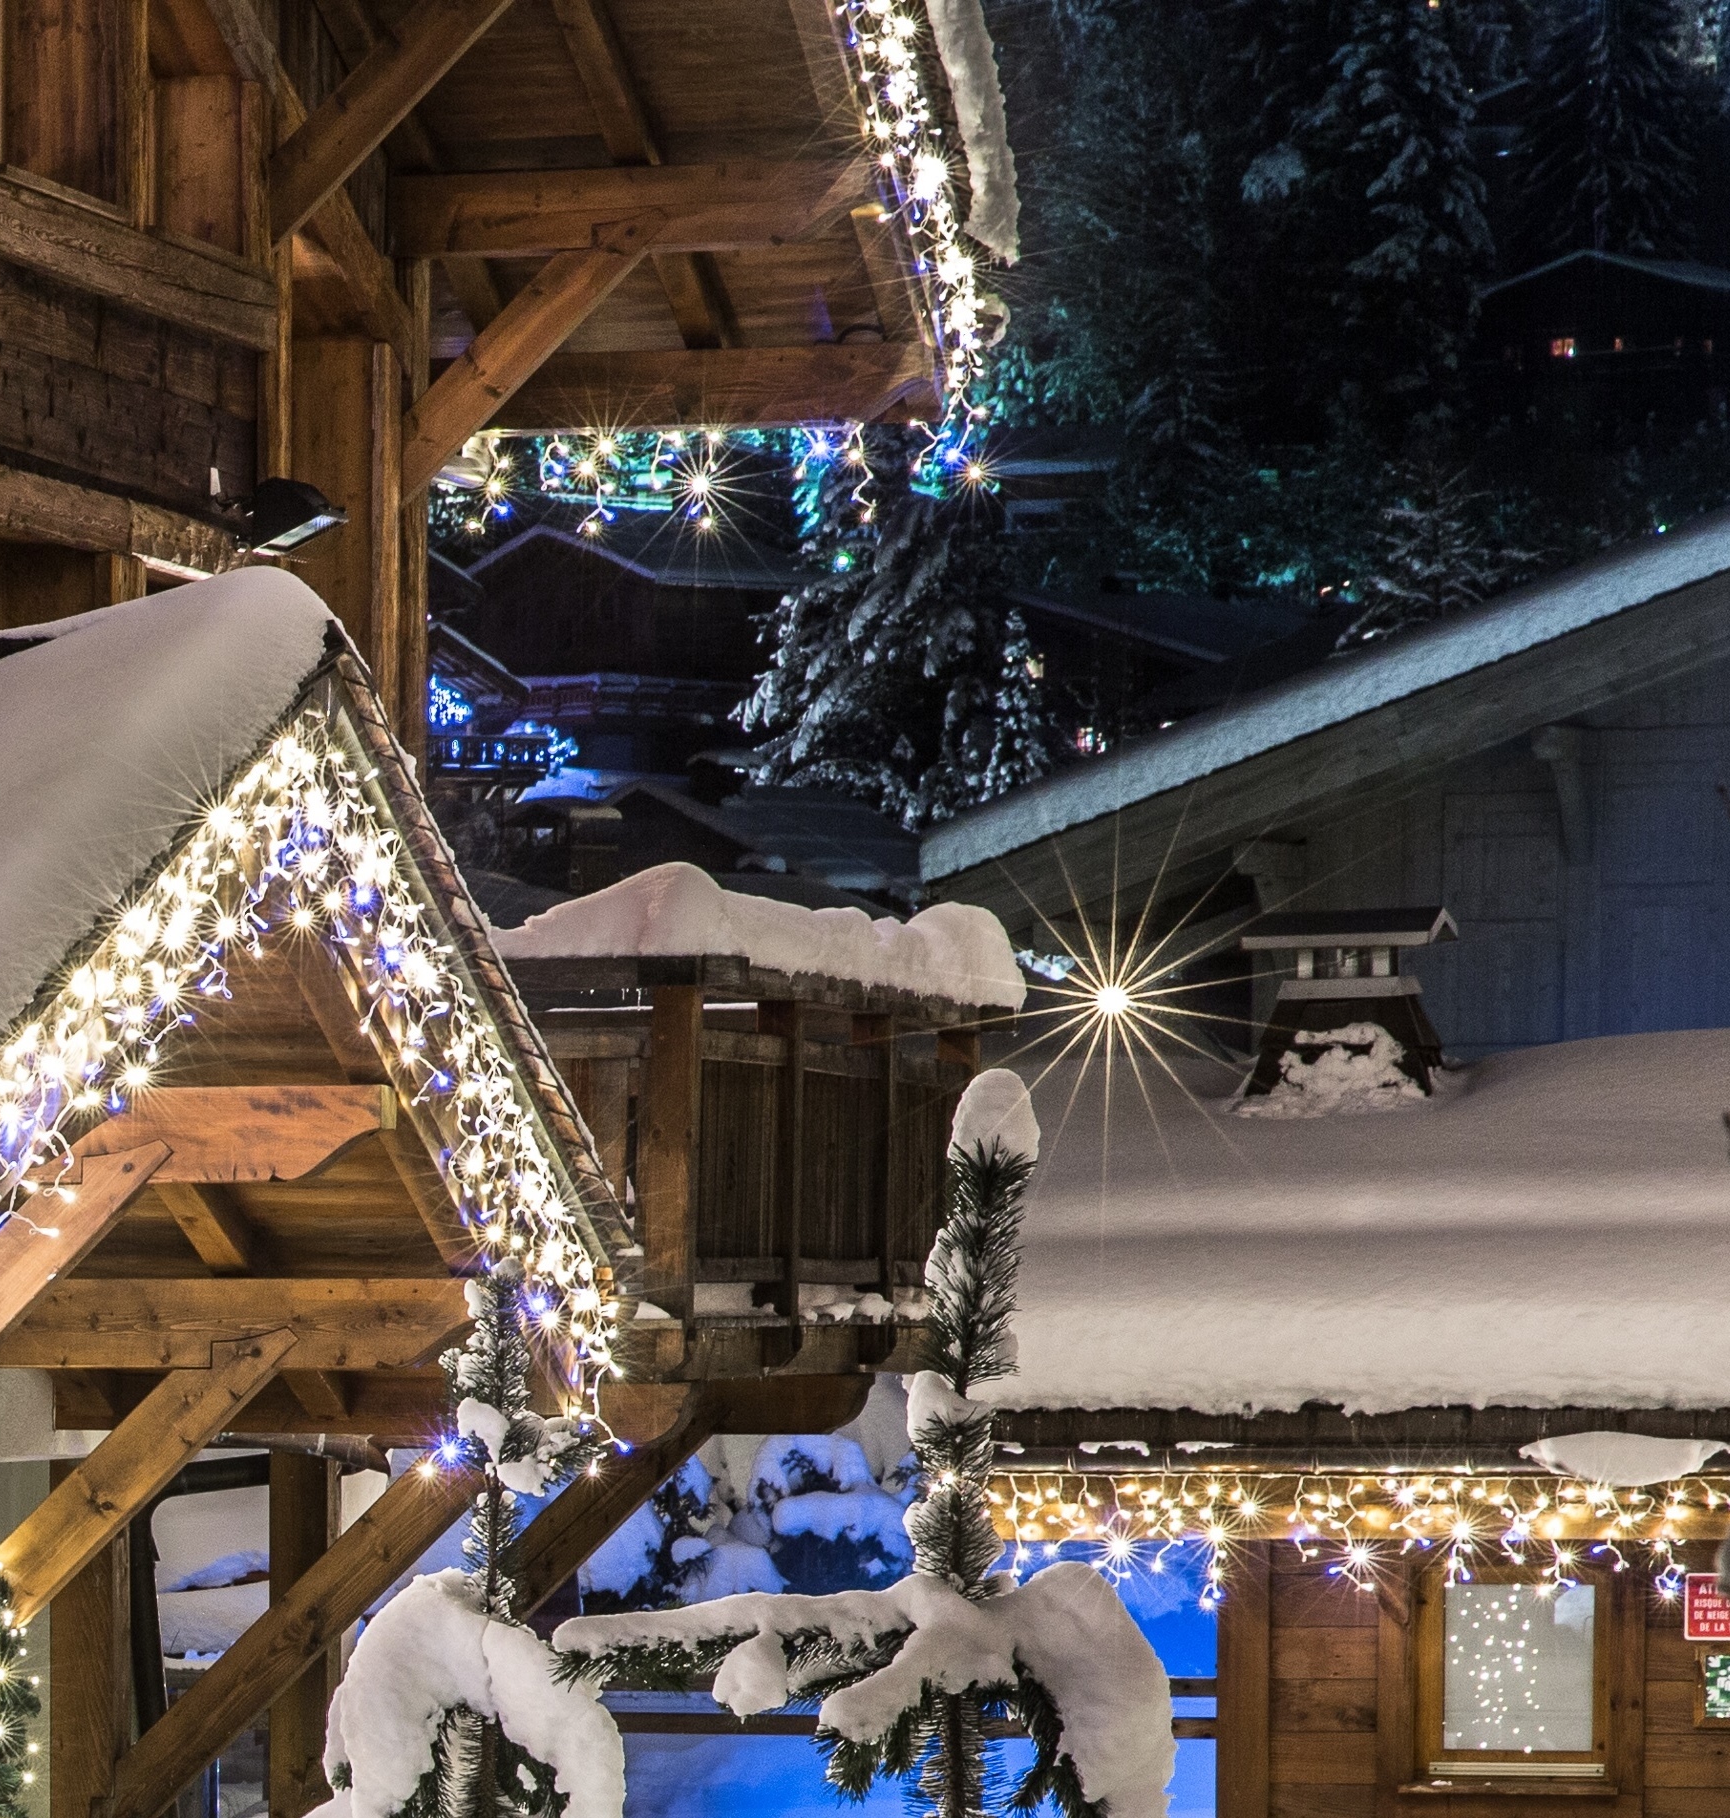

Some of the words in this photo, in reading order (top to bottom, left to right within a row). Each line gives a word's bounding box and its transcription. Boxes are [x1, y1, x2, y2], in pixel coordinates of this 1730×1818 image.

[1694, 1599, 1722, 1609] RISQUE
[1694, 1611, 1703, 1620] DE
[1707, 1611, 1729, 1620] NEIGE
[1700, 1622, 1709, 1631] DE
[1714, 1622, 1725, 1631] LA
